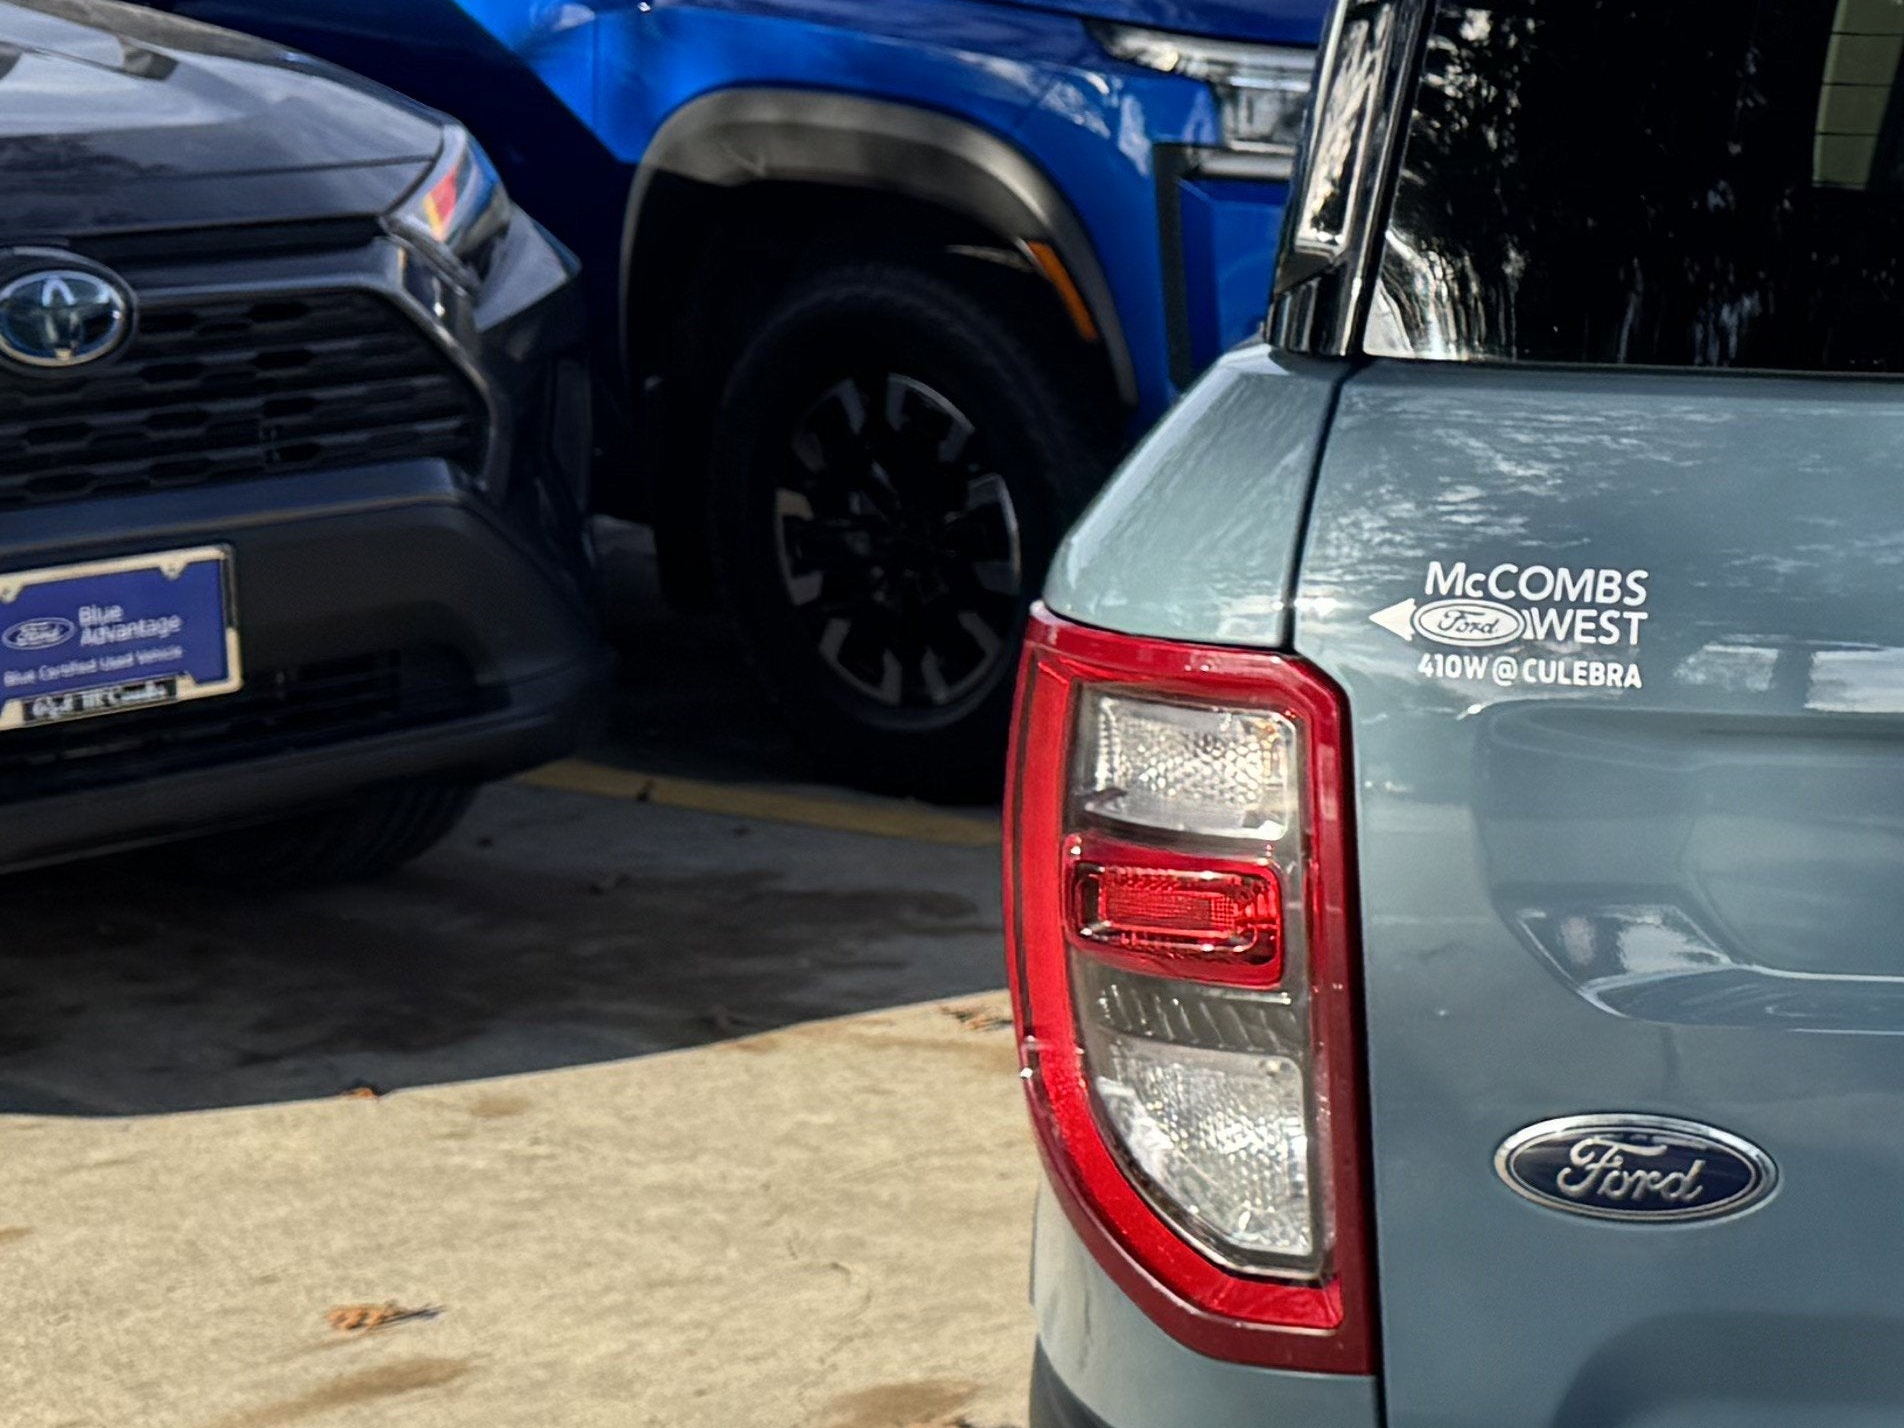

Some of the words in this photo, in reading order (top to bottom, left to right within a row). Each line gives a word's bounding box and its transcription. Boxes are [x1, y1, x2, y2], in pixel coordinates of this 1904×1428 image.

[1424, 561, 1649, 606] McCOMBS
[78, 604, 124, 626] Blue
[80, 615, 182, 647] Advantage
[1437, 610, 1498, 635] Ford
[1528, 607, 1649, 646] WEST
[1418, 652, 1488, 679] 410W
[1522, 658, 1643, 689] CULEBRA
[1556, 1137, 1705, 1204] Ford
